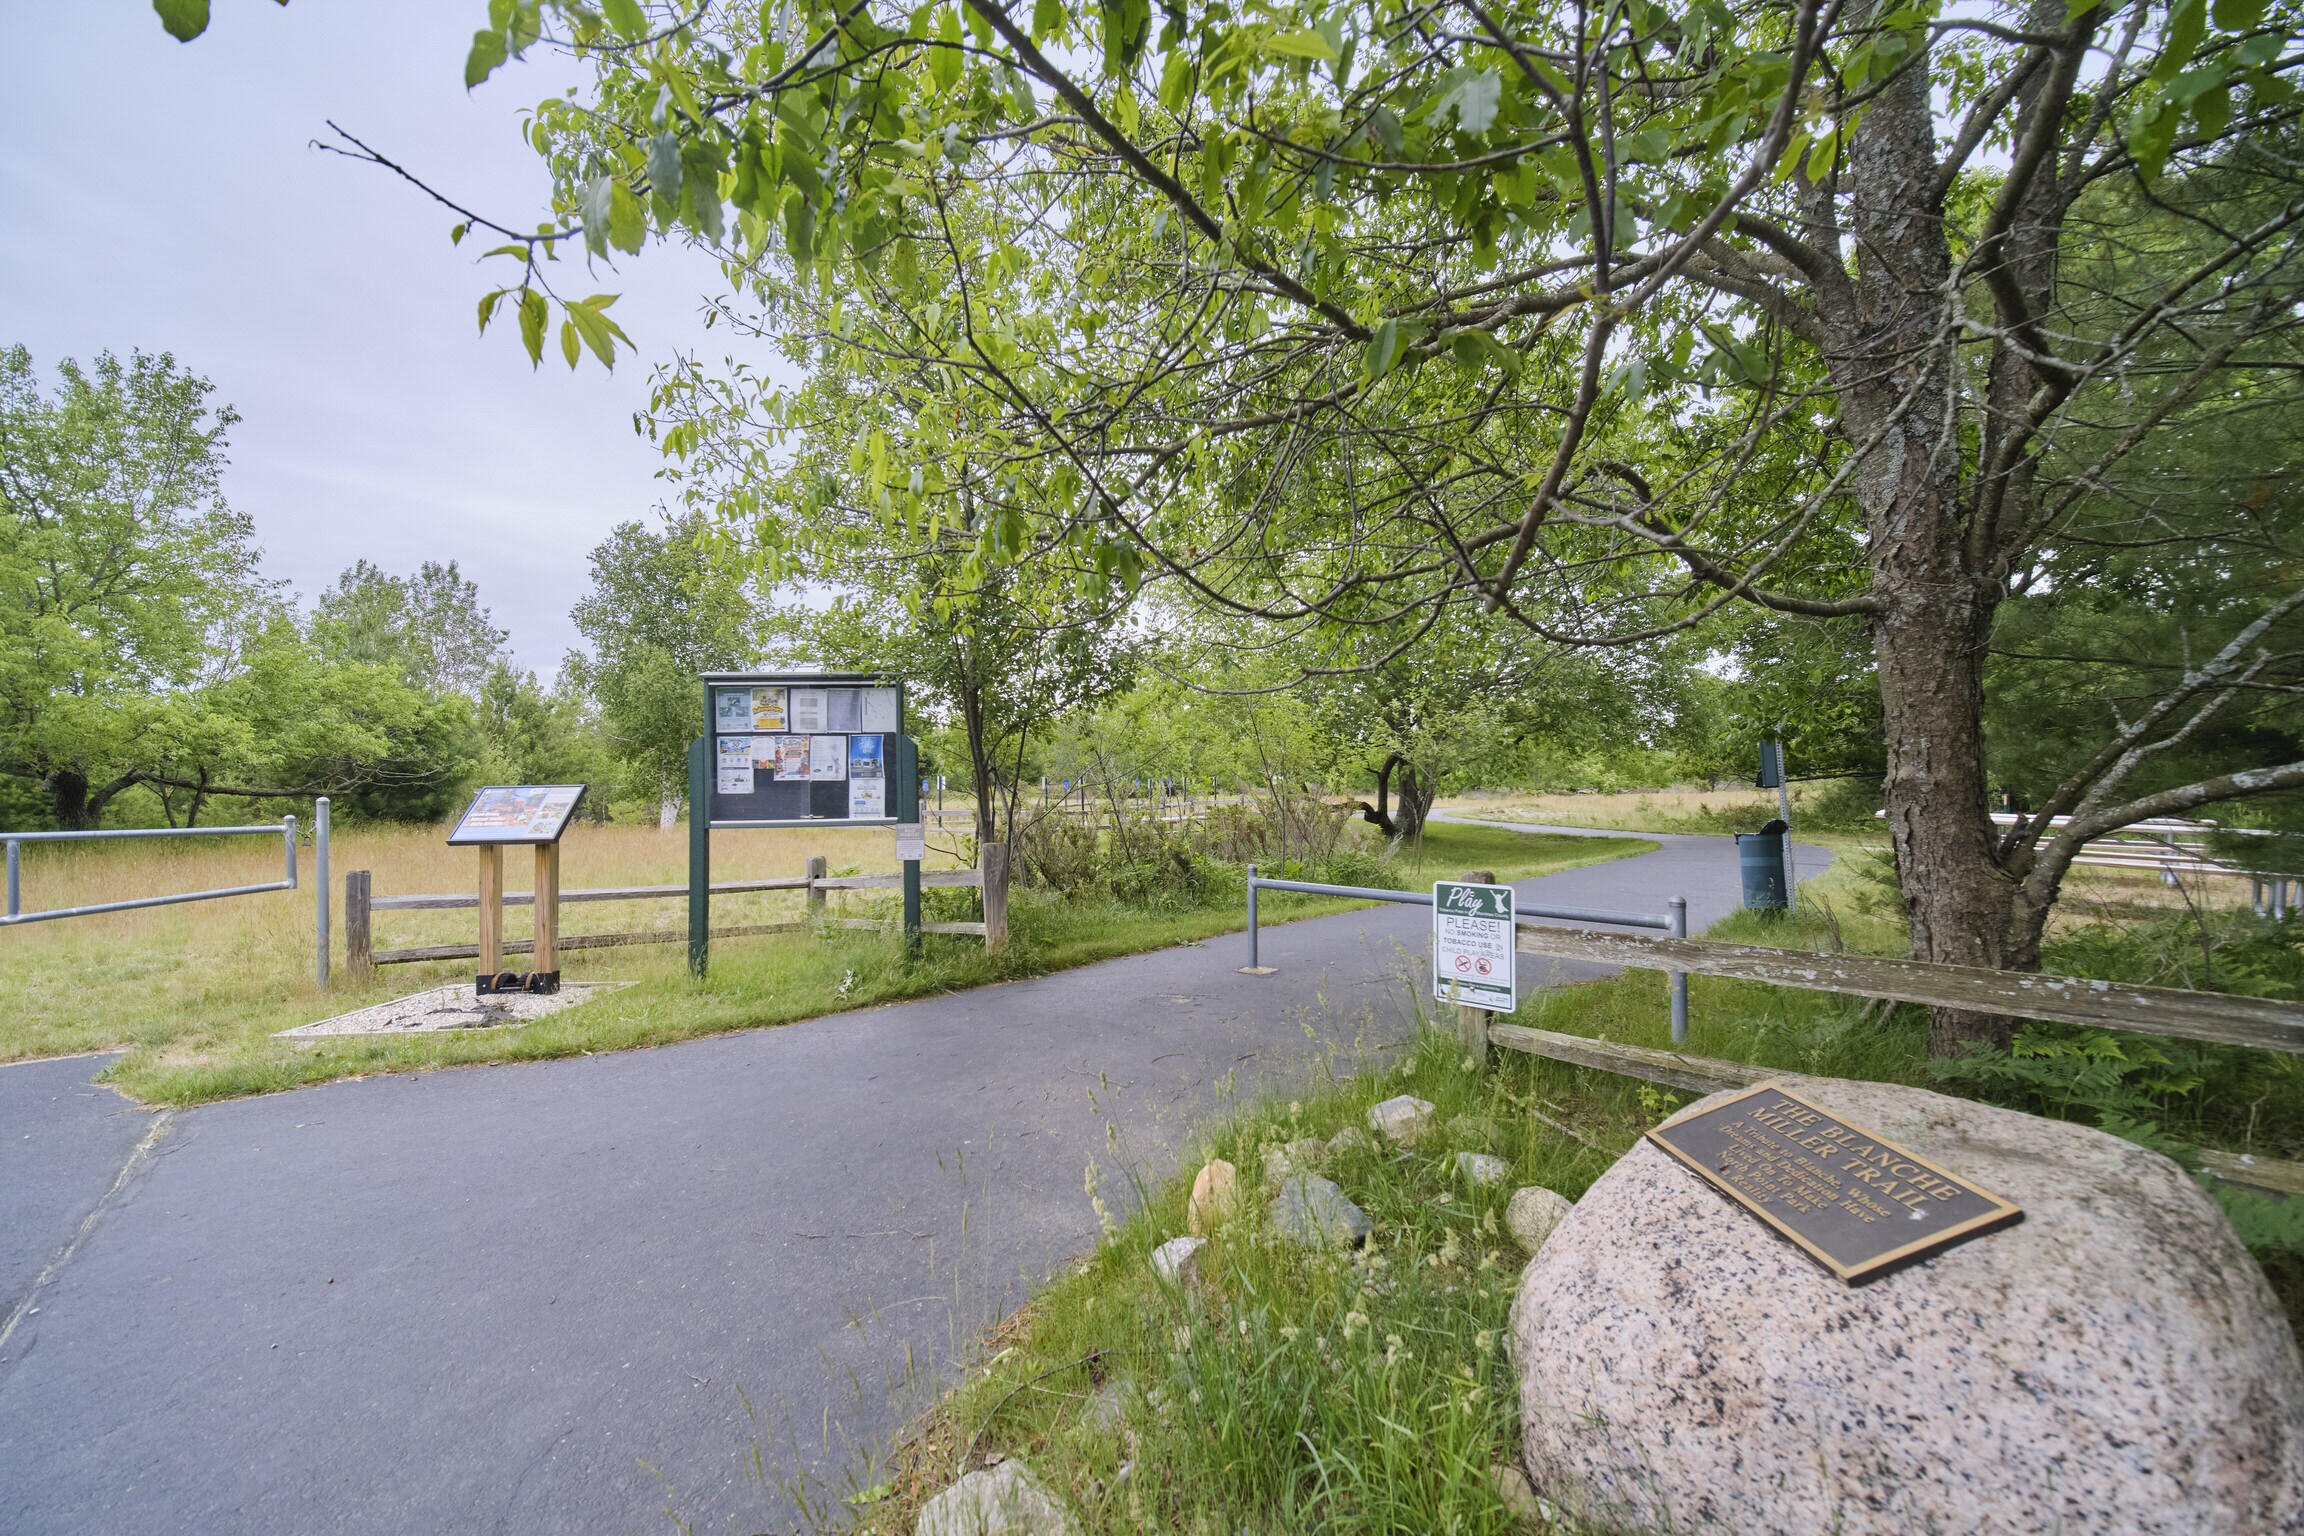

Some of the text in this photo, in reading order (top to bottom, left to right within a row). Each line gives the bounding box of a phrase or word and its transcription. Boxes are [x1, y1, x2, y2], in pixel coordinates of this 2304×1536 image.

[1446, 887, 1483, 916] Play
[1447, 917, 1500, 932] PLEASE!
[1444, 937, 1476, 946] TOBACCO
[1456, 930, 1489, 938] SMOKING
[1718, 1150, 1810, 1214] North Point Park
[1720, 1125, 1876, 1223] Dreams and Dedication Have
[1728, 1144, 1829, 1209] Lived On To Make
[1744, 1127, 1780, 1150] Tribute
[1780, 1149, 1793, 1158] to
[1794, 1157, 1841, 1190] Blanche,
[1848, 1188, 1892, 1217] Whose
[1747, 1107, 1929, 1211] MILLER TRAIL
[1772, 1099, 1962, 1201] THE BLANCHE
[1732, 1174, 1774, 1203] Reality
